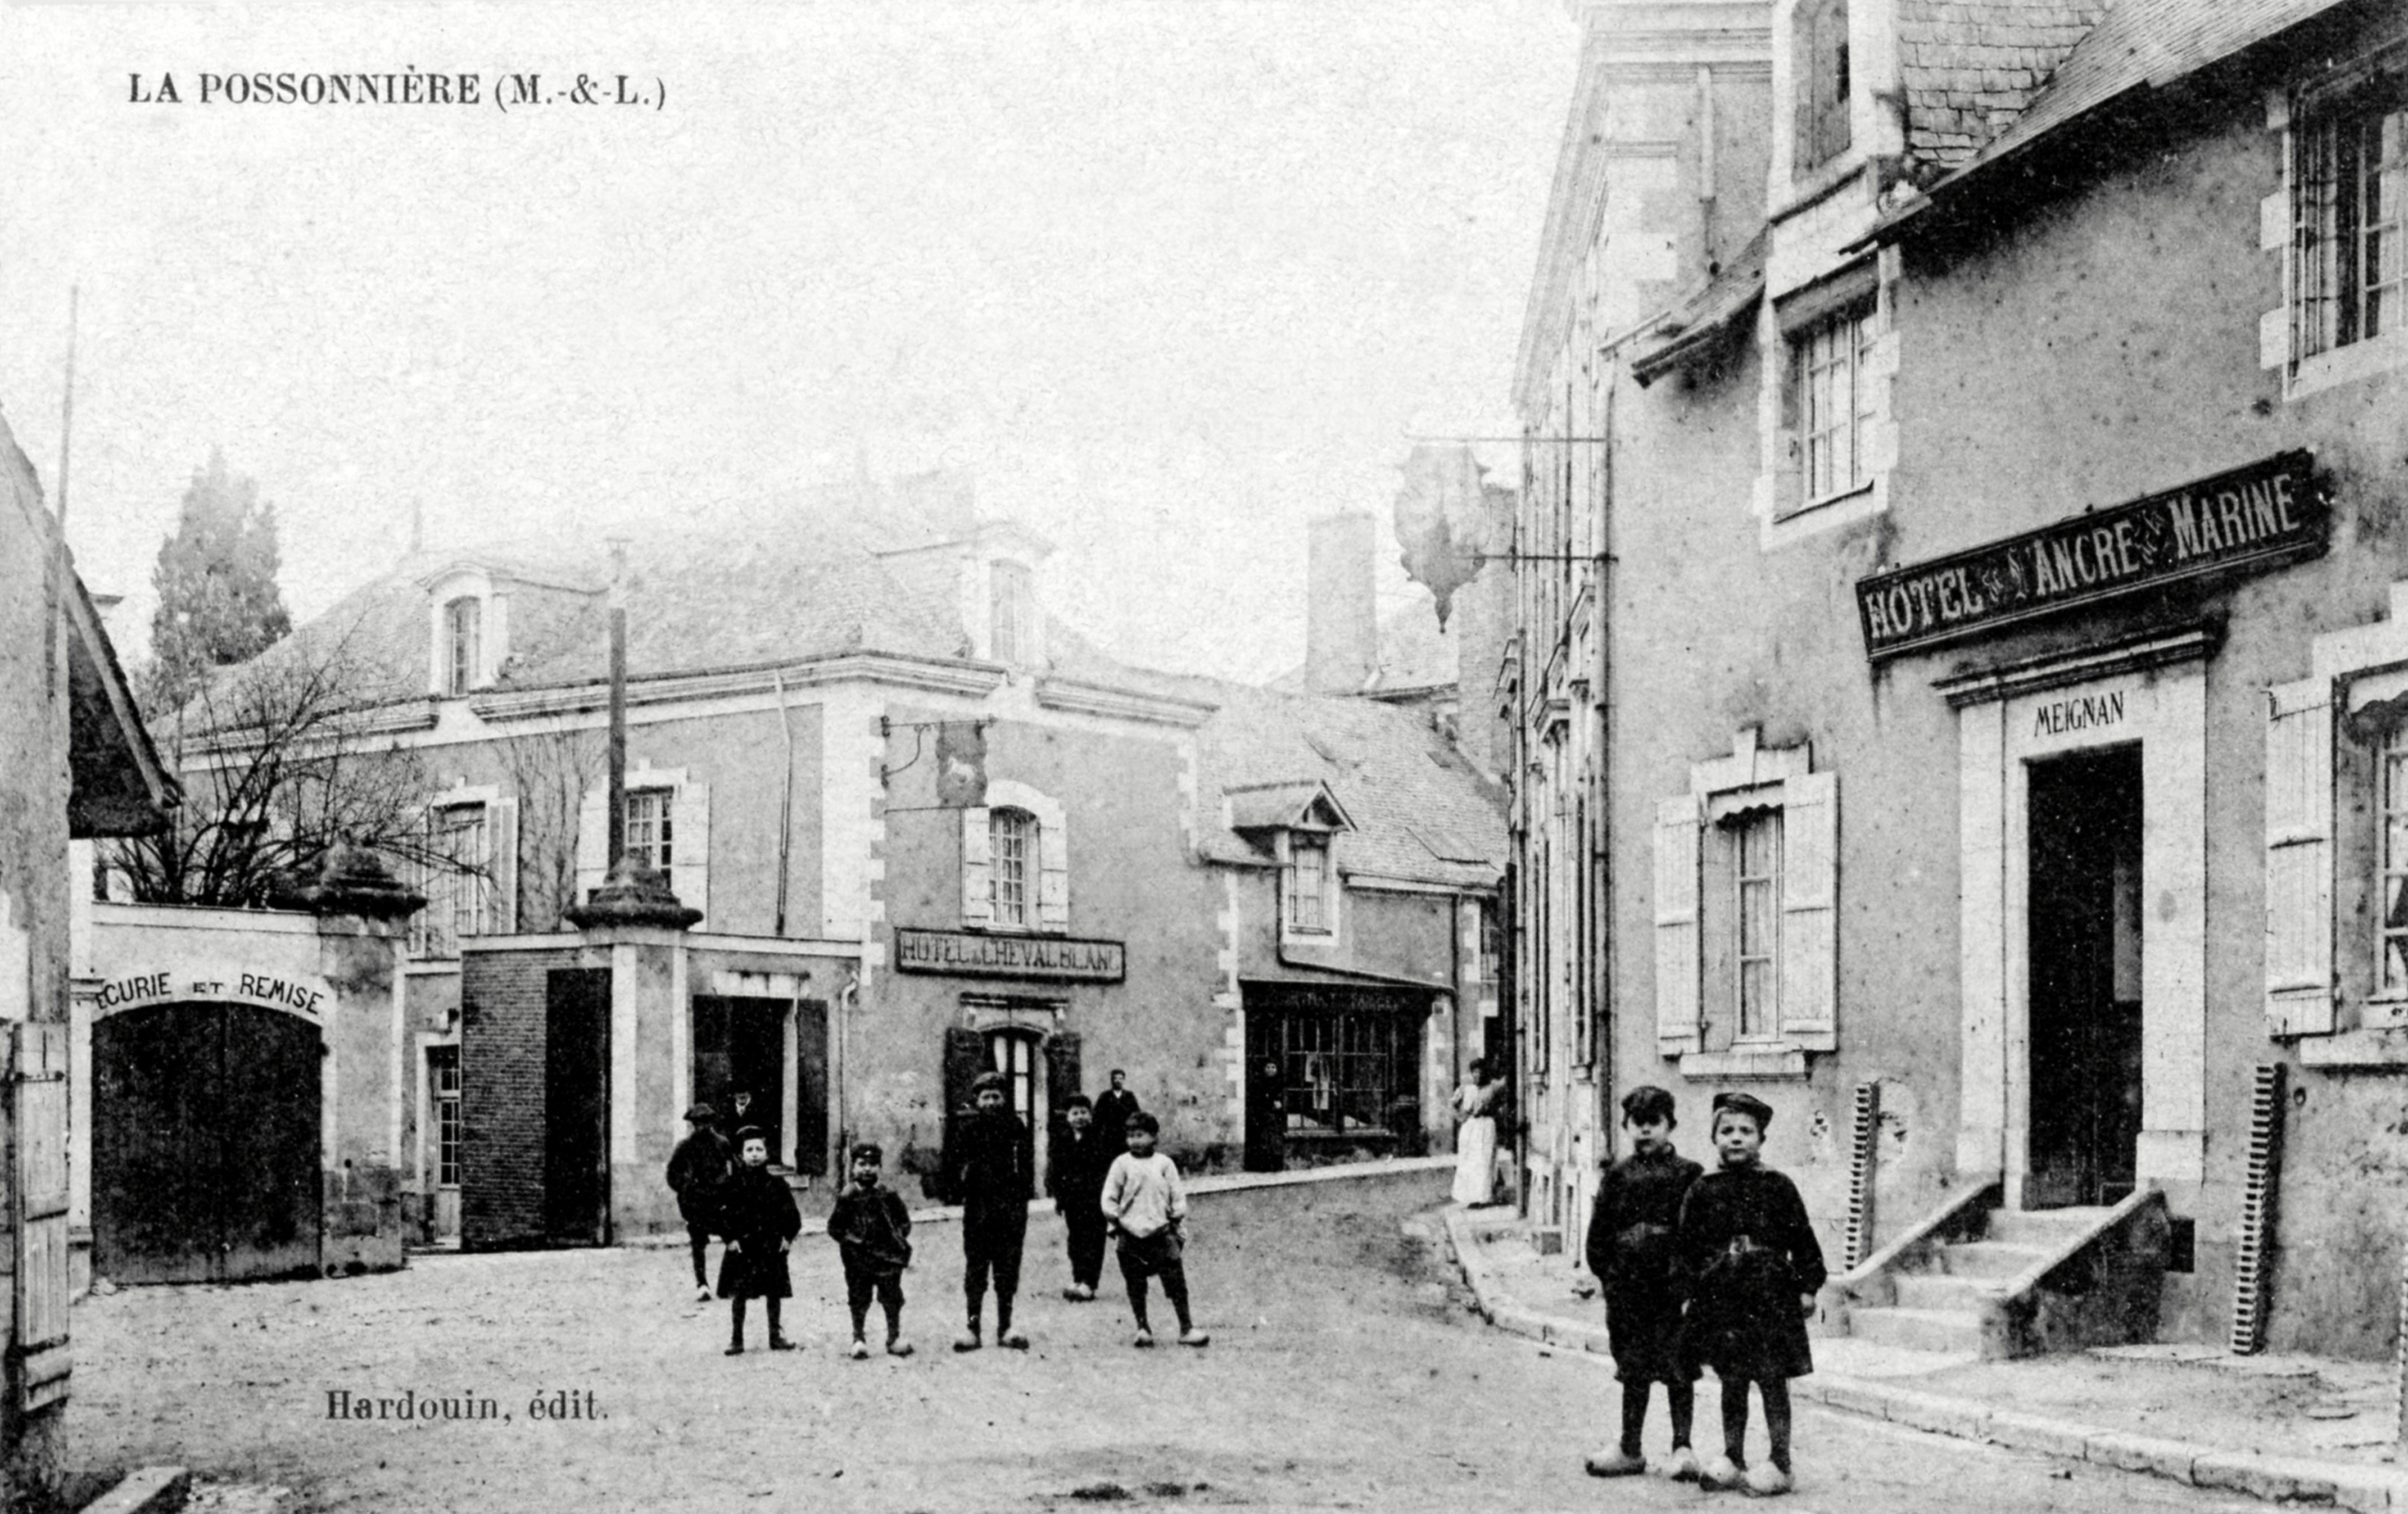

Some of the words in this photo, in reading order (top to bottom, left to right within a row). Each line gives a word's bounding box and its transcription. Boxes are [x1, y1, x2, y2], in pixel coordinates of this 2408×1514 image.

[2167, 473, 2300, 559] MARINE
[2034, 690, 2125, 738] MEIGNAN
[981, 938, 1057, 968] CHEVAL
[1059, 944, 1121, 970] BLANC
[193, 981, 225, 995] ET
[239, 973, 324, 1015] REMISE
